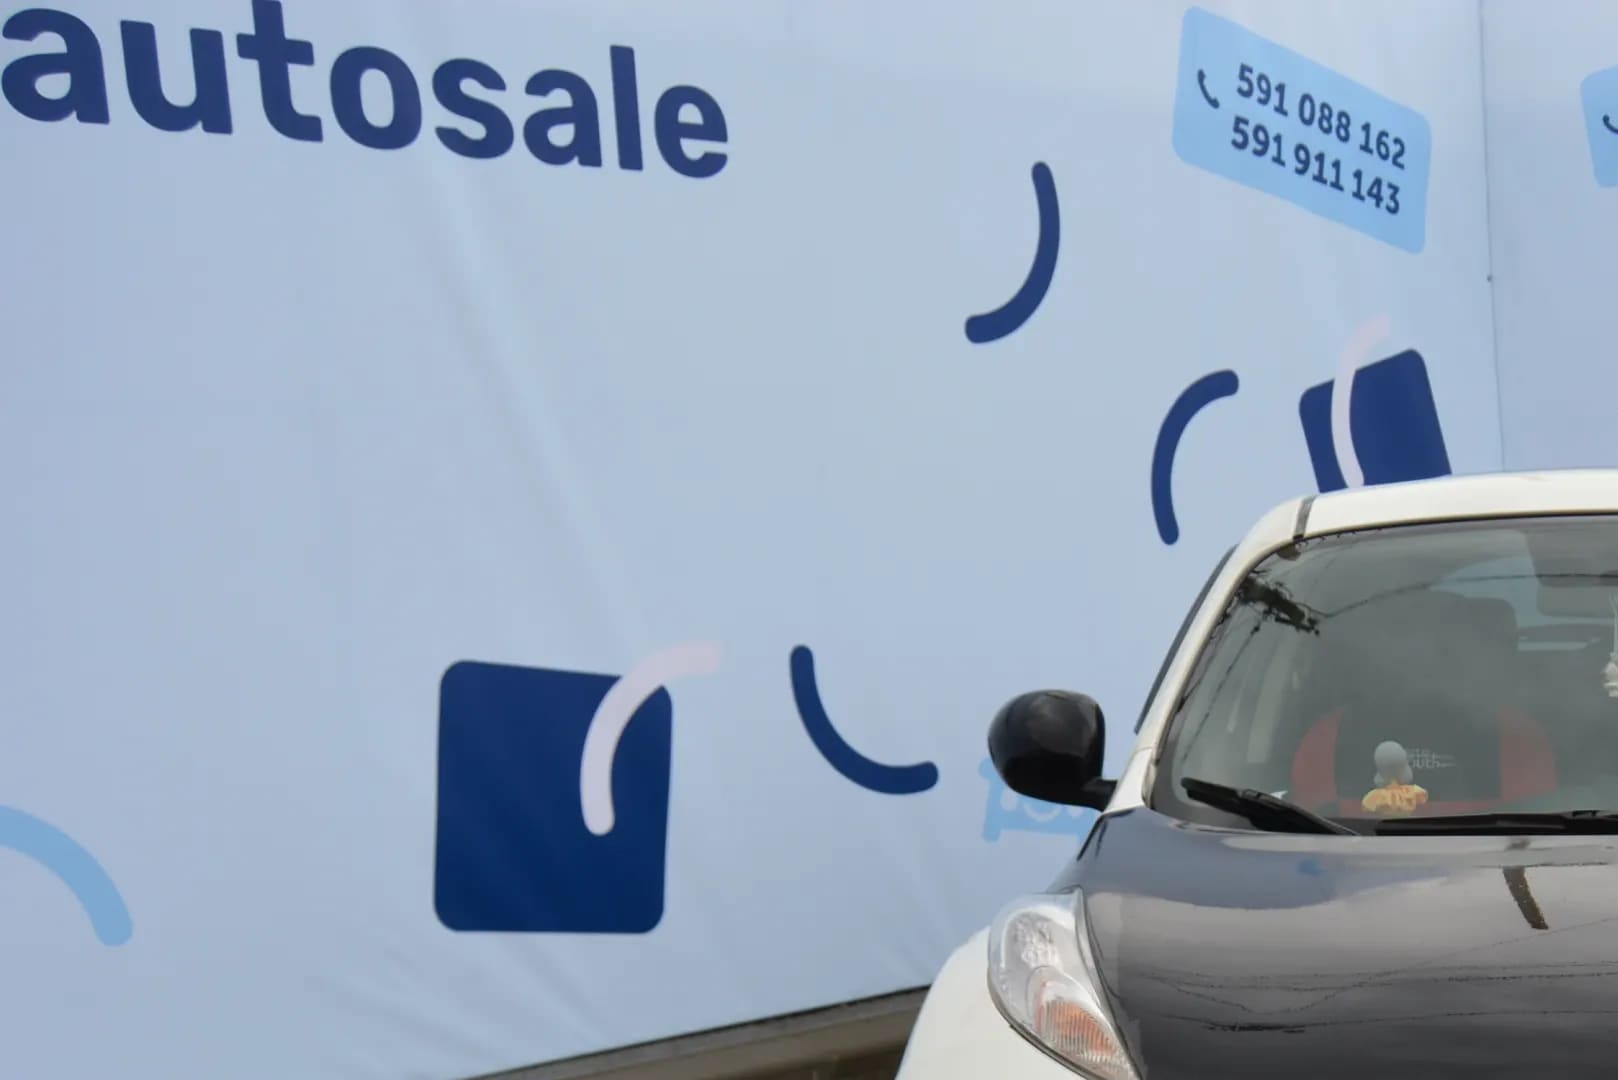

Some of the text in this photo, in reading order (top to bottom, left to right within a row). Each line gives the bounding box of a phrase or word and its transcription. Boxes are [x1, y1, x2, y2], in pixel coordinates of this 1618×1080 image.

[0, 0, 729, 179] autosale
[1236, 62, 1405, 170] 591 088 162
[1231, 114, 1400, 215] 591 911 143
